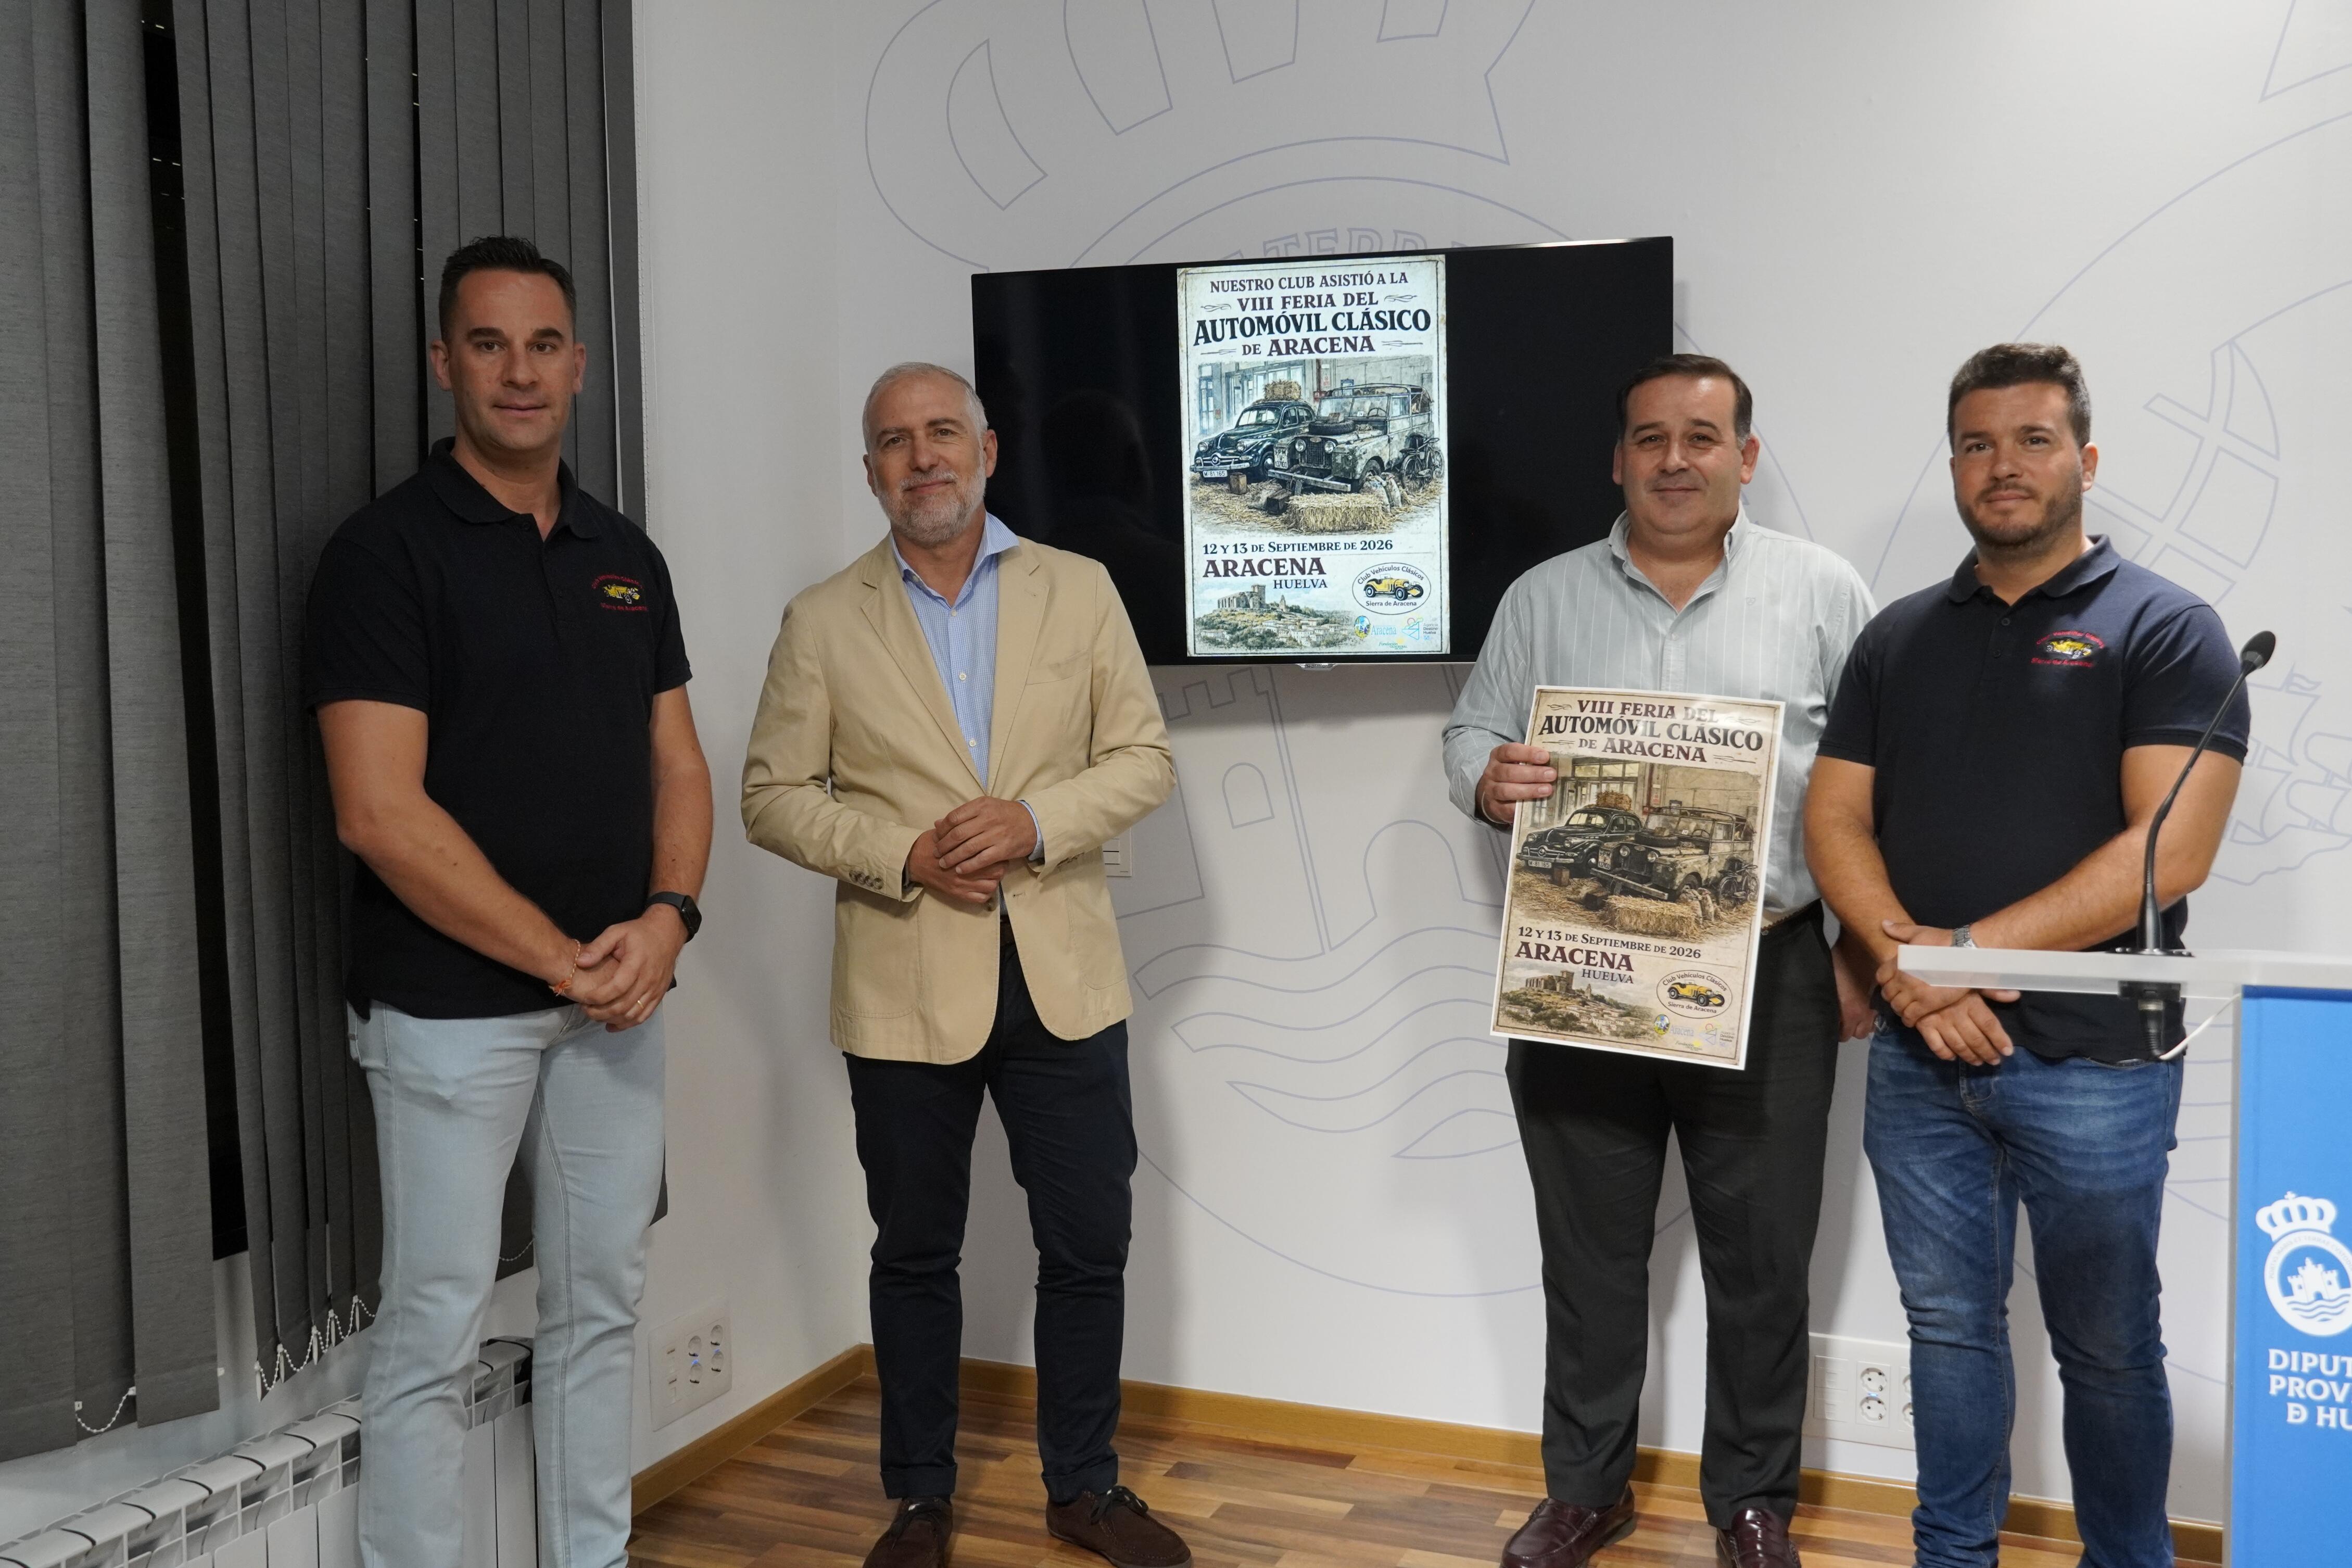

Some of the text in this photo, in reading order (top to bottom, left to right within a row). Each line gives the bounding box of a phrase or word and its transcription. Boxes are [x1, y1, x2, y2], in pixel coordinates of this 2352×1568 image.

[1210, 271, 1408, 293] NUESTRO CLUB ASISTIÓ A LA
[1237, 292, 1378, 311] VIII FERIA DEL
[1194, 308, 1431, 346] AUTOMÓVIL CLÁSICO
[1242, 336, 1375, 356] DE ARACENA
[1203, 544, 1217, 554] 12
[1220, 545, 1229, 554] Y
[1233, 543, 1248, 553] 13
[1251, 544, 1264, 552] DE
[1268, 541, 1339, 552] SEPTIEMBRE
[1360, 540, 1393, 550] 2026
[1203, 558, 1326, 578] ARACENA
[1358, 565, 1424, 584] Club Vehículos Clásicos
[1273, 579, 1327, 589] HUELVA
[1371, 625, 1396, 635] Aracena
[1577, 700, 1719, 723] VIII FERIA DEL
[1538, 715, 1763, 751] AUTOMÓVIL CLÁSICO
[1578, 738, 1707, 763] DE ARACENA
[1518, 926, 1701, 958] 12 Y 13 DE SEPTIEMBRE DE 2026
[1515, 941, 1635, 971] ARACENA
[1582, 969, 1634, 984] HUELVA
[1663, 976, 1676, 985] Club
[1706, 976, 1727, 991] Clásicos
[1670, 1025, 1694, 1036] Aracena
[2269, 1374, 2352, 1403] PROV
